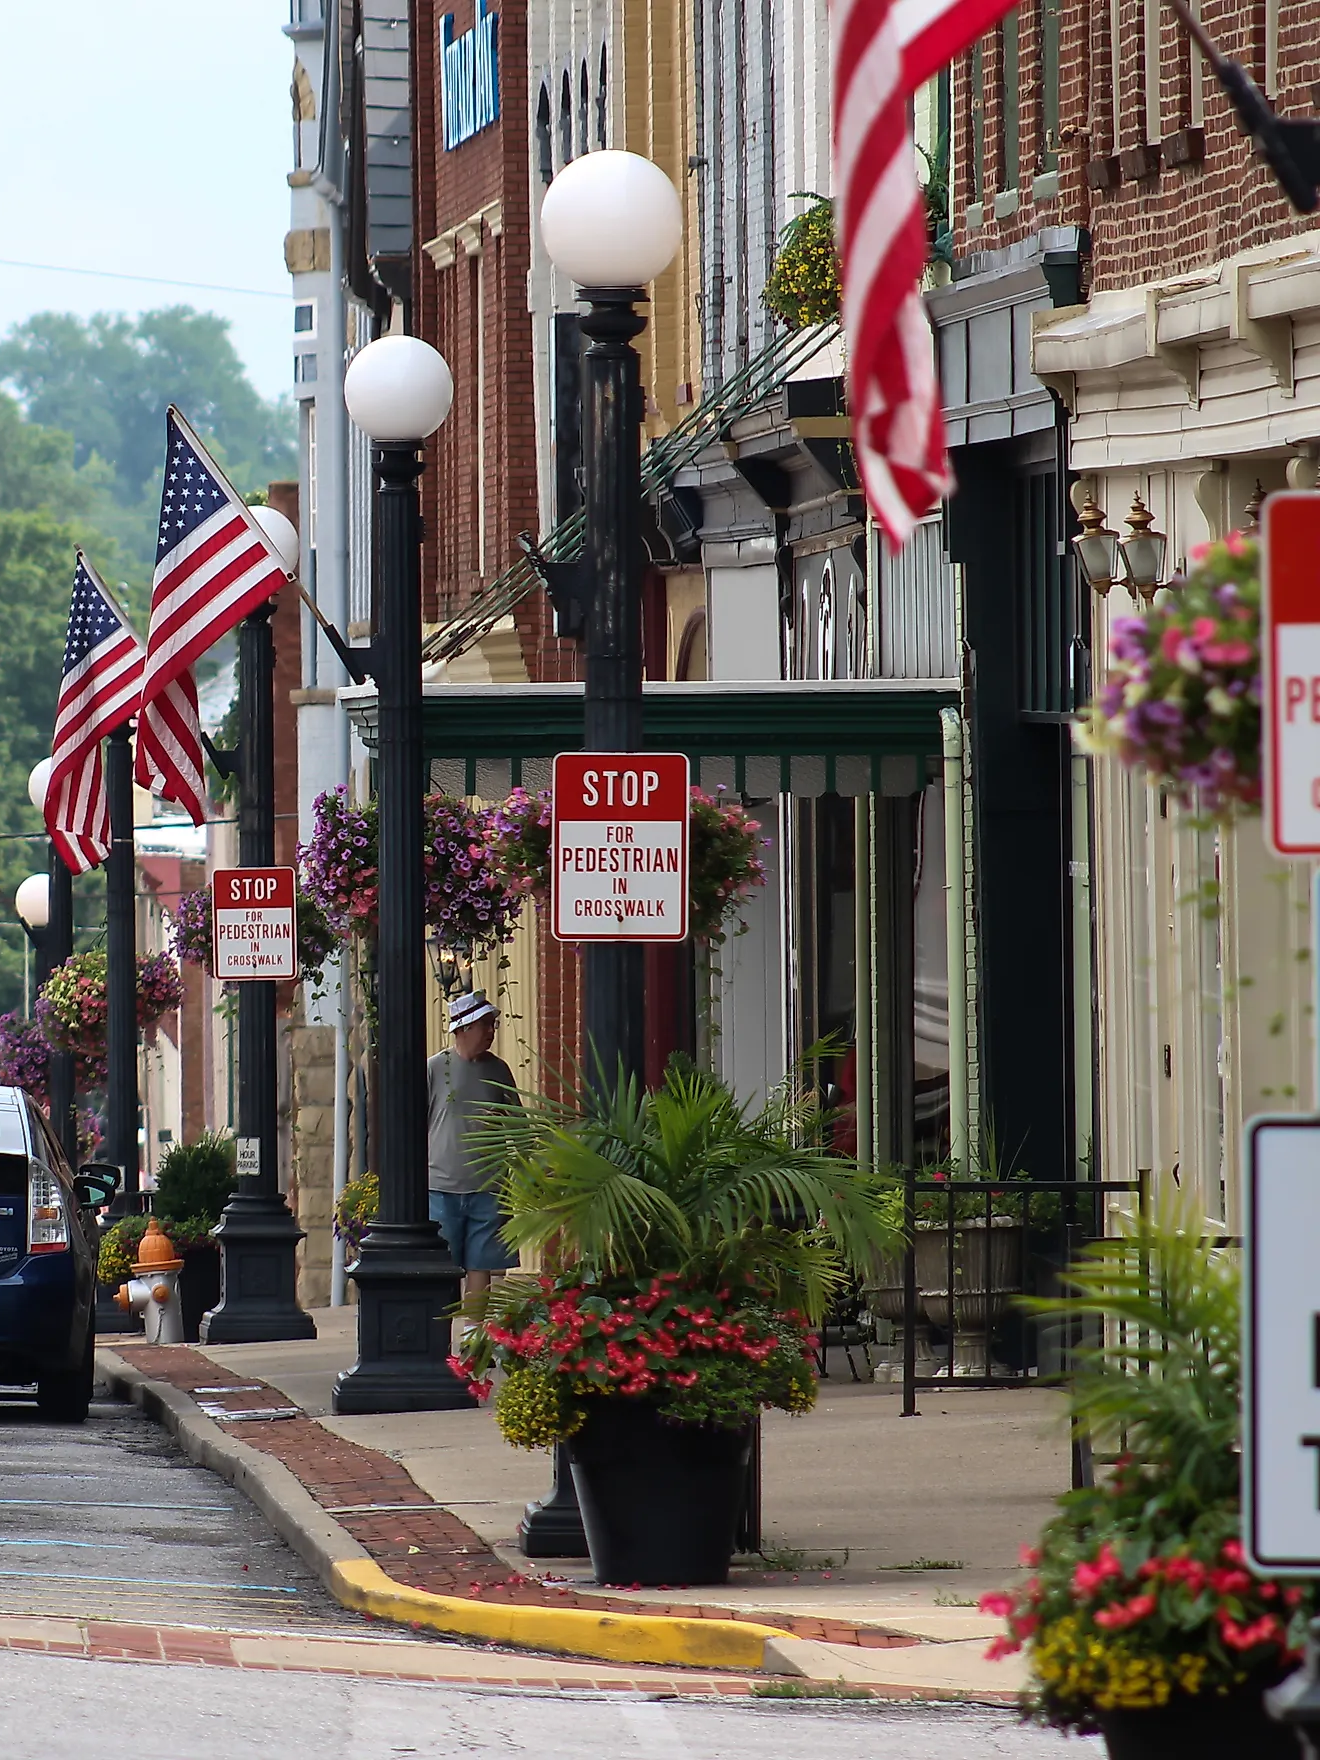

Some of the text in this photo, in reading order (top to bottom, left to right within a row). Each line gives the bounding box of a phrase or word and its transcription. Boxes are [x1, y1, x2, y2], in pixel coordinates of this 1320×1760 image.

[582, 770, 659, 807] STOP
[606, 826, 634, 843] FOR
[562, 847, 678, 873] PEDESTRIAN
[230, 877, 277, 901] STOP
[612, 877, 627, 895] IN
[245, 911, 263, 922] FOR
[574, 899, 665, 917] CROSSWALK
[219, 923, 290, 940] PEDESTRIAN
[250, 941, 260, 953] IN
[227, 954, 284, 966] CROSSWALK
[239, 1150, 256, 1159] HOUR
[237, 1160, 259, 1169] PARKING
